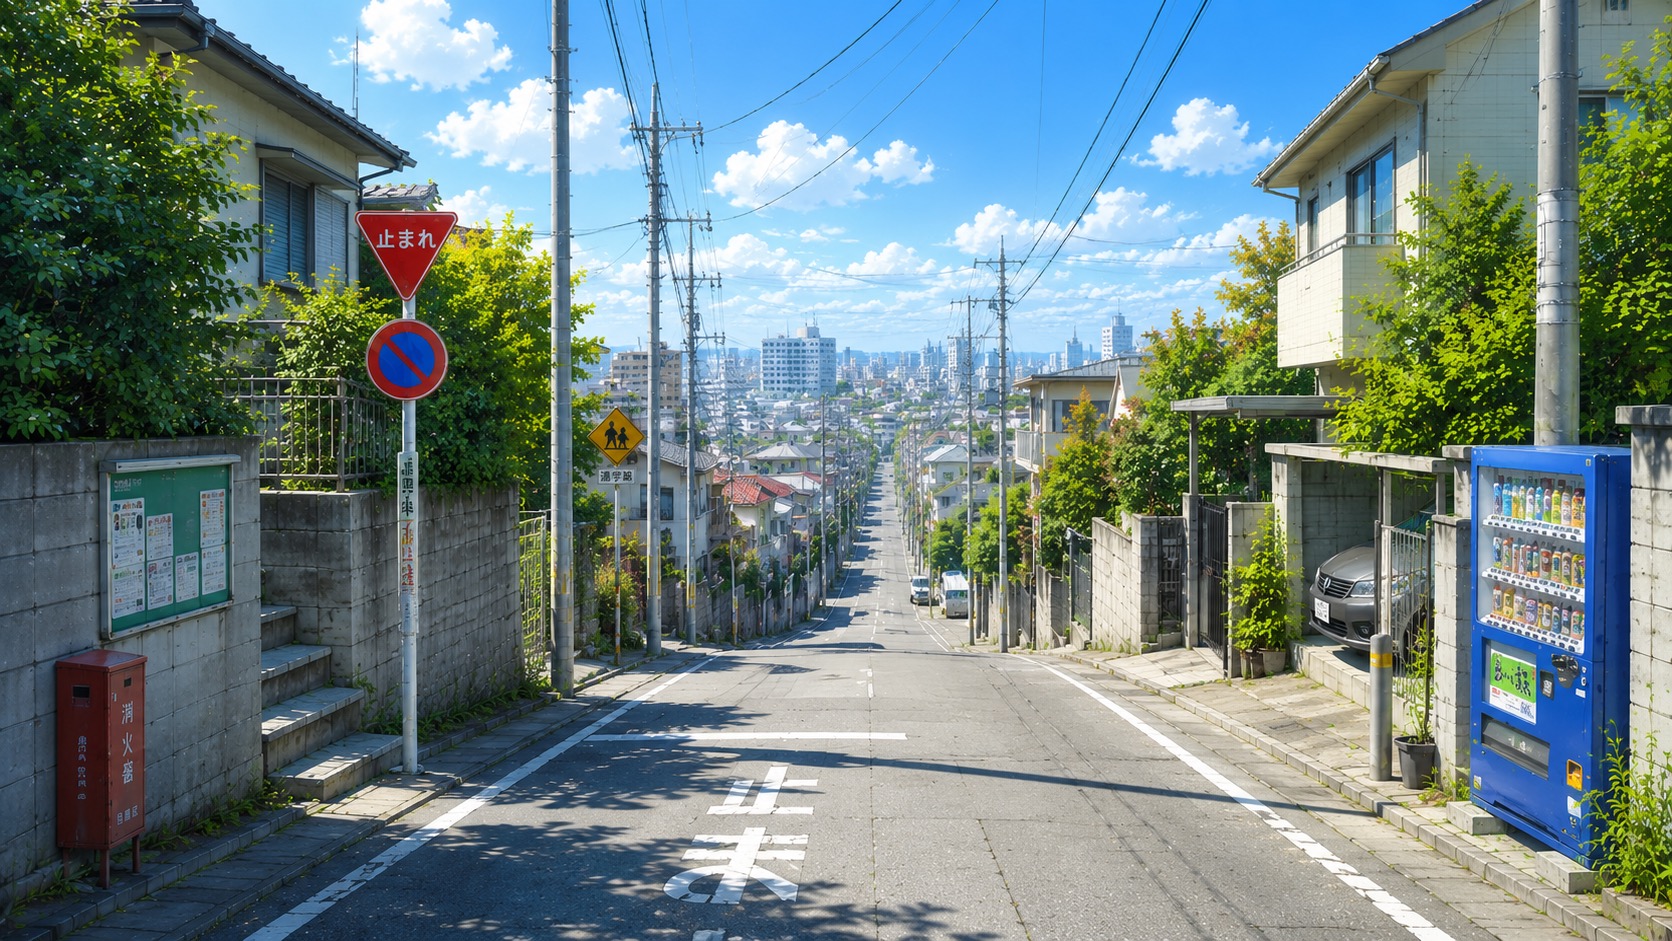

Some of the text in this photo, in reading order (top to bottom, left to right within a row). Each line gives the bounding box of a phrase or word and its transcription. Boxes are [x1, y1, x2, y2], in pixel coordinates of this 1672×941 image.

[376, 228, 437, 249] 止まれ
[663, 765, 819, 941] 止ま
